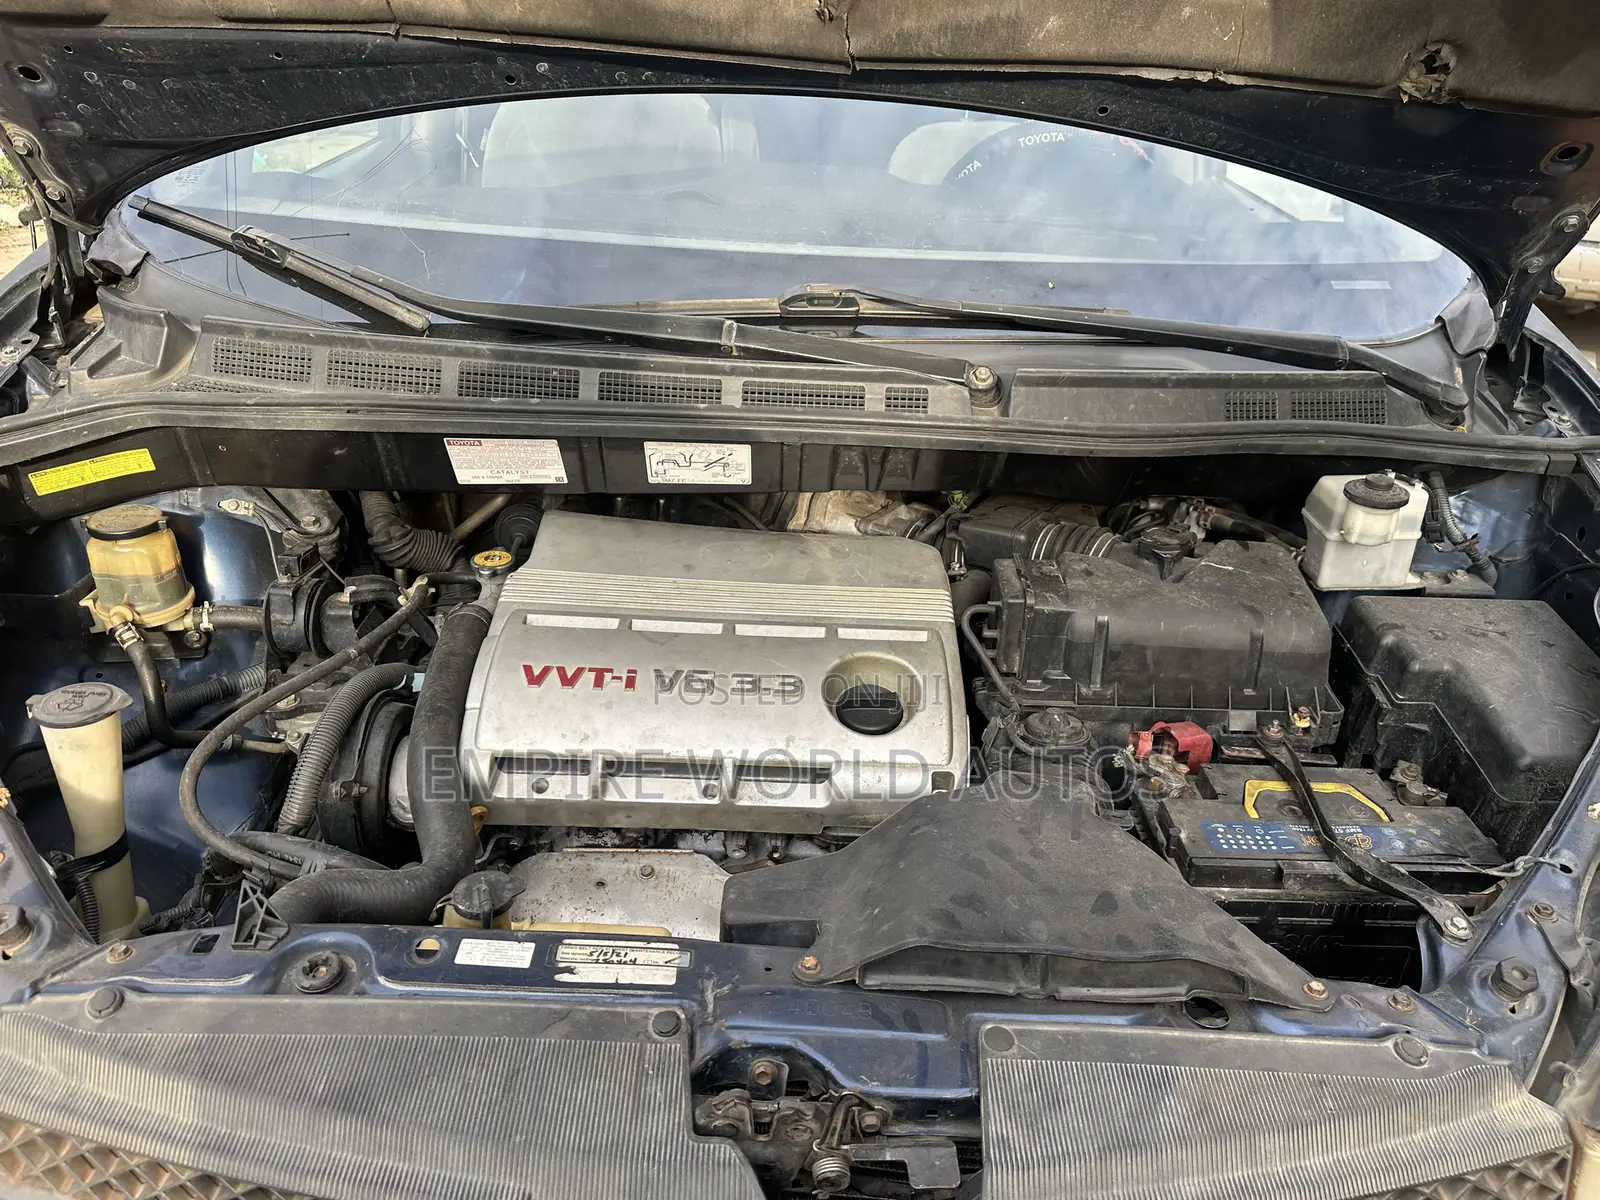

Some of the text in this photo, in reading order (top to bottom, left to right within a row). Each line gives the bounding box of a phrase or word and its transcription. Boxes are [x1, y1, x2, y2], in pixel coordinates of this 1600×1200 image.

[1017, 132, 1065, 148] TOYOTA
[522, 664, 804, 699] VVT-i V6 3.3
